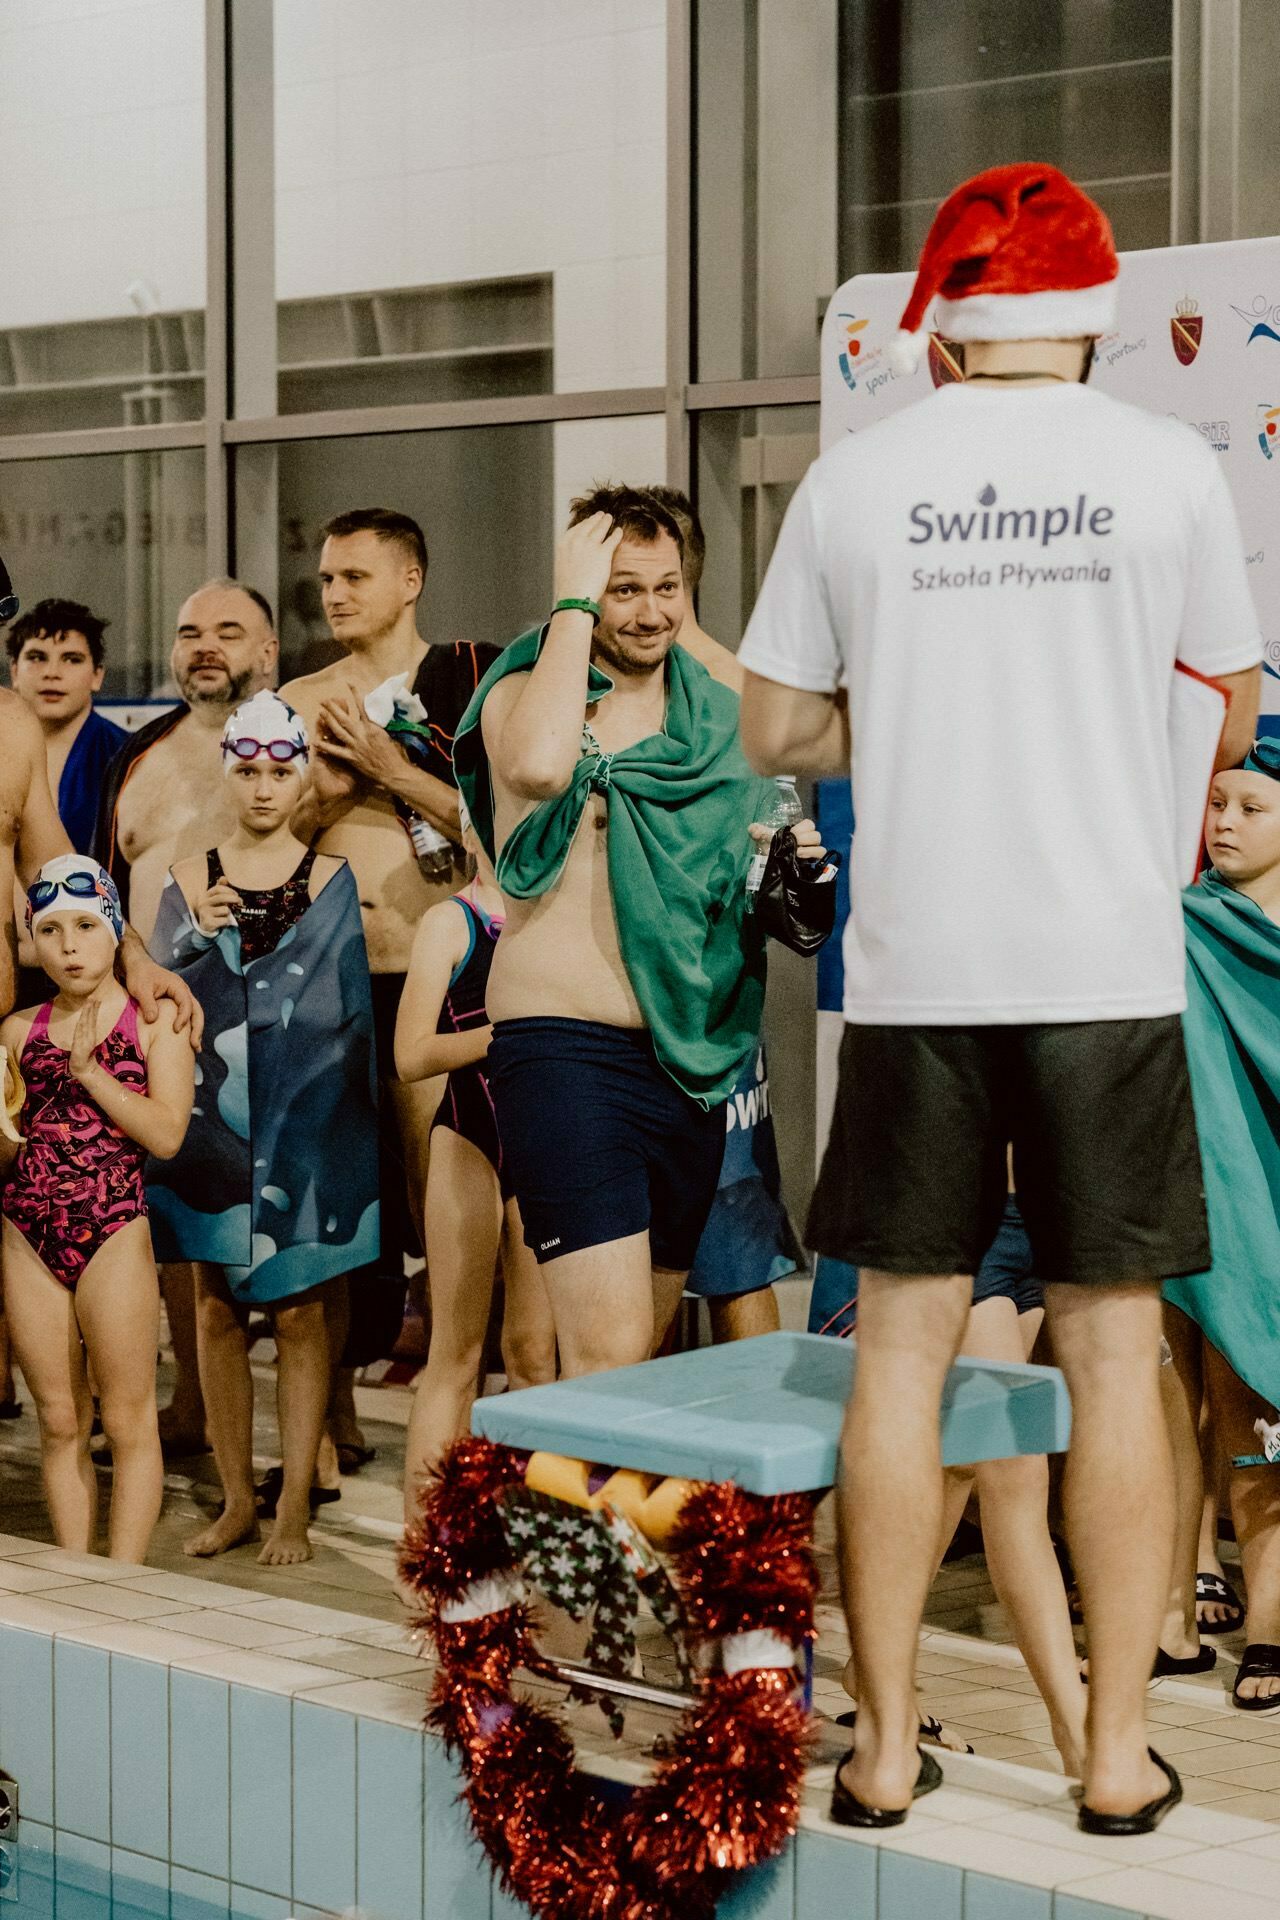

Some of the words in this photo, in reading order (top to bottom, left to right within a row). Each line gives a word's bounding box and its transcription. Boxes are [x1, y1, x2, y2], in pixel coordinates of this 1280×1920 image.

[908, 482, 1114, 547] Swimple
[911, 564, 992, 592] Szkoła
[1000, 558, 1112, 590] Pływania
